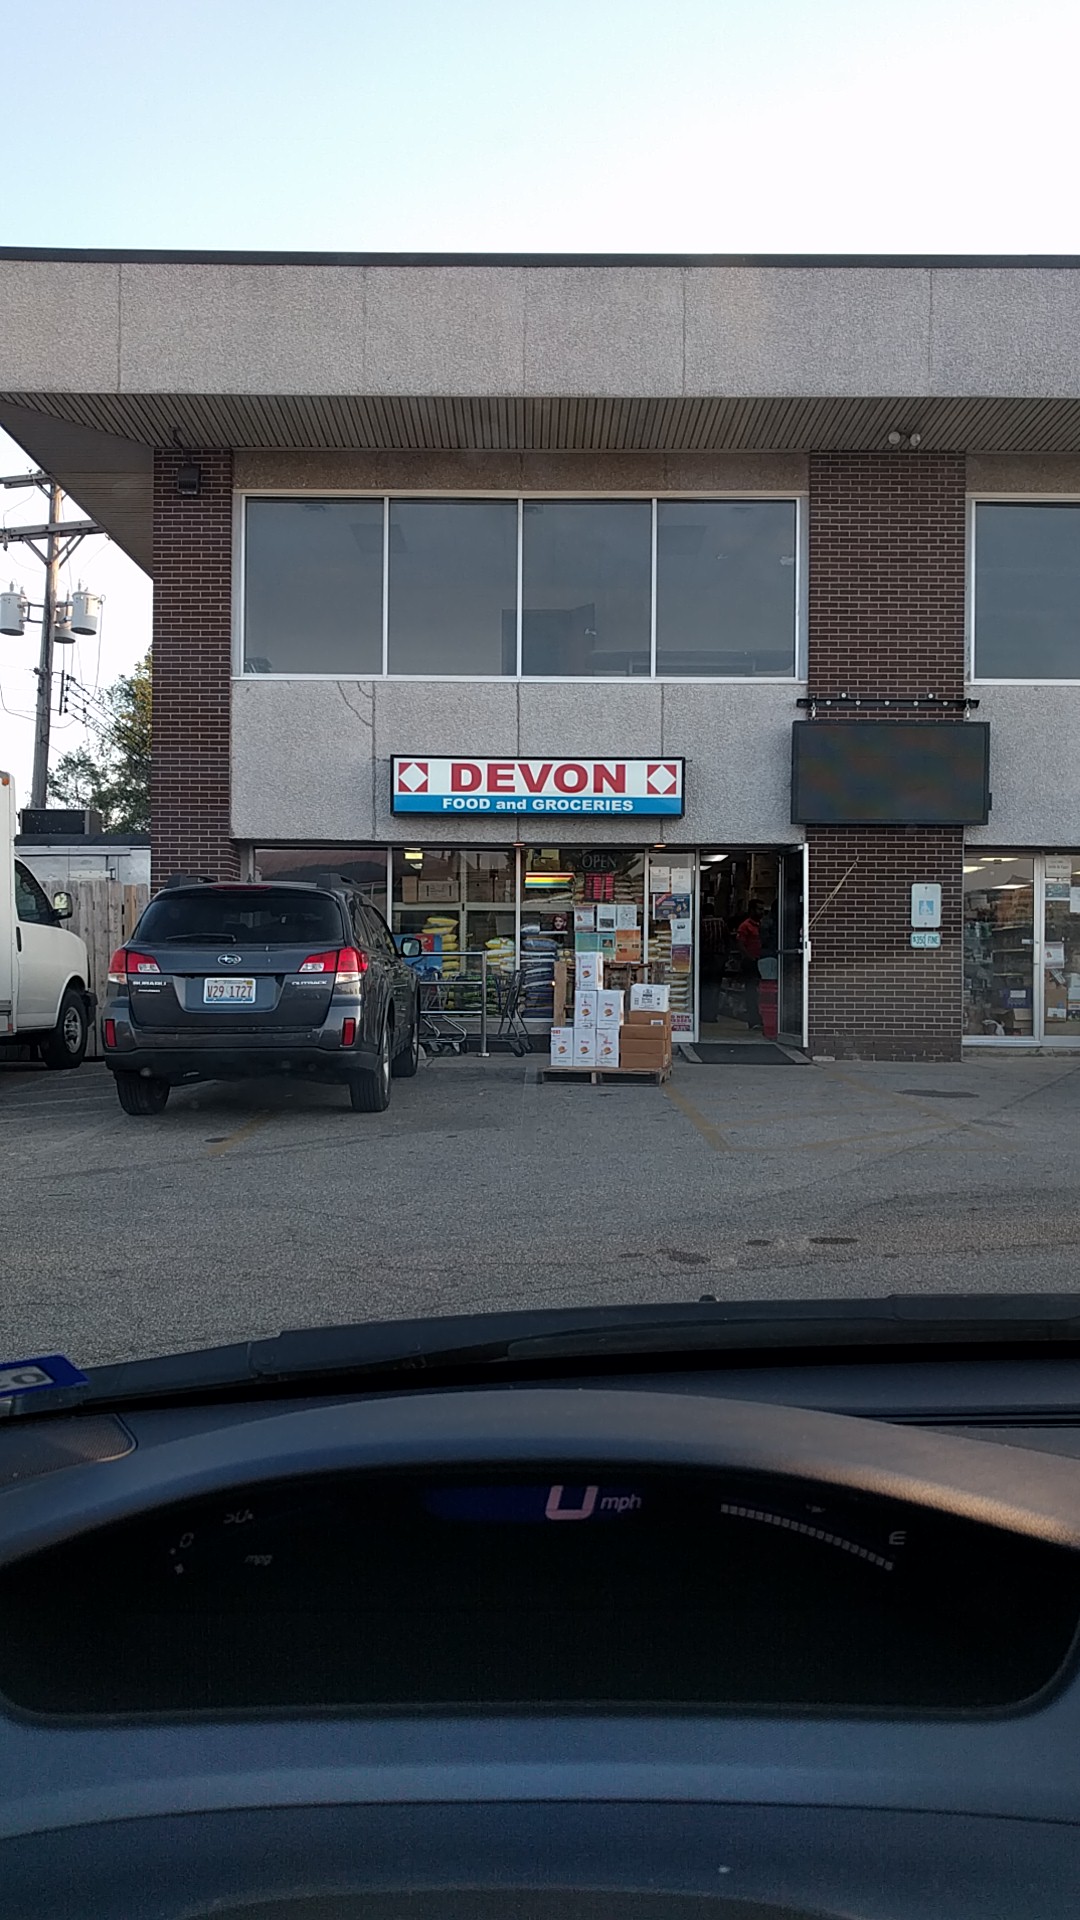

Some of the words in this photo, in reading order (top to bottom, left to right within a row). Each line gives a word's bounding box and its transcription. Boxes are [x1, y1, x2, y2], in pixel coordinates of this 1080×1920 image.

[451, 763, 626, 793] DEVON
[442, 798, 491, 810] FOOD
[496, 799, 526, 811] and
[532, 800, 634, 812] GROCERIES
[581, 854, 617, 868] OPEN
[927, 935, 939, 945] FINE
[207, 985, 224, 998] V29
[229, 985, 253, 998] 1727
[600, 1494, 642, 1513] mph
[888, 1530, 907, 1546] E
